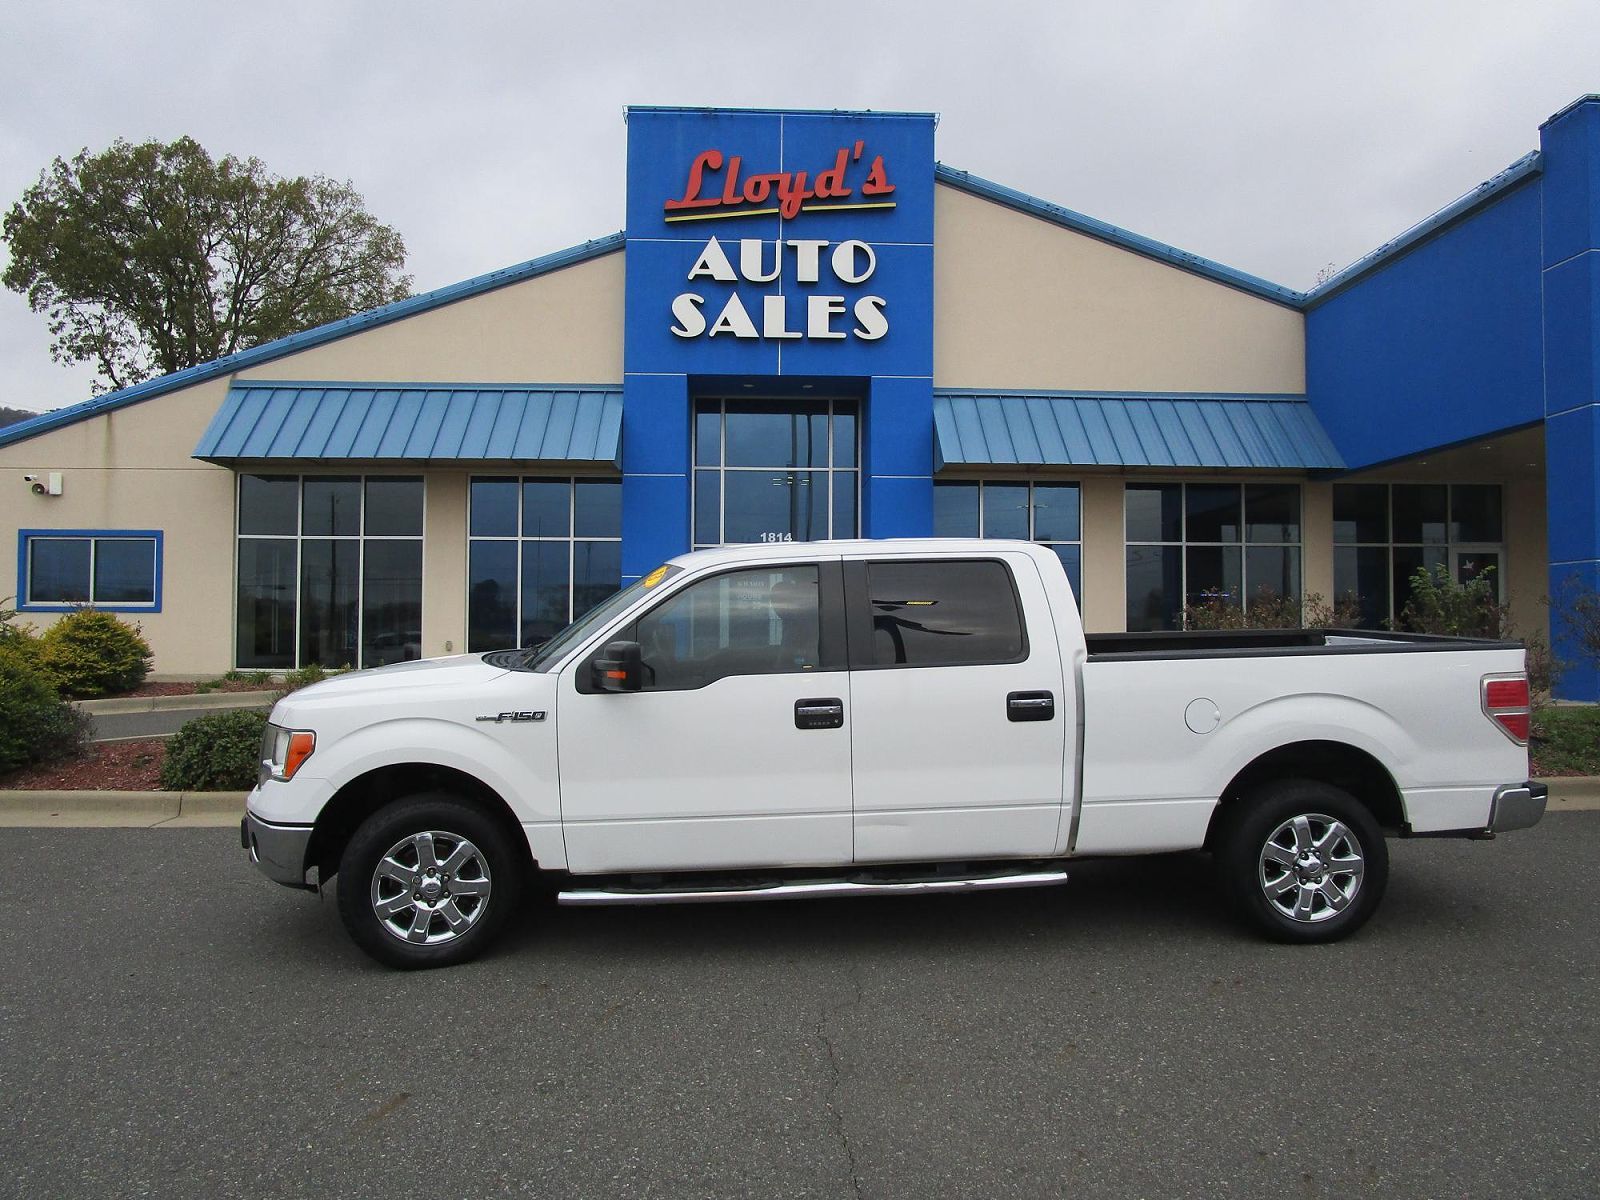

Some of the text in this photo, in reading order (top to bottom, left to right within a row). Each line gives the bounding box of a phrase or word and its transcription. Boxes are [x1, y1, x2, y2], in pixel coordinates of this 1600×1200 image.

[664, 140, 896, 220] Lloyd's
[687, 235, 876, 284] AUTO
[670, 291, 889, 340] SALES
[760, 532, 793, 543] 1814
